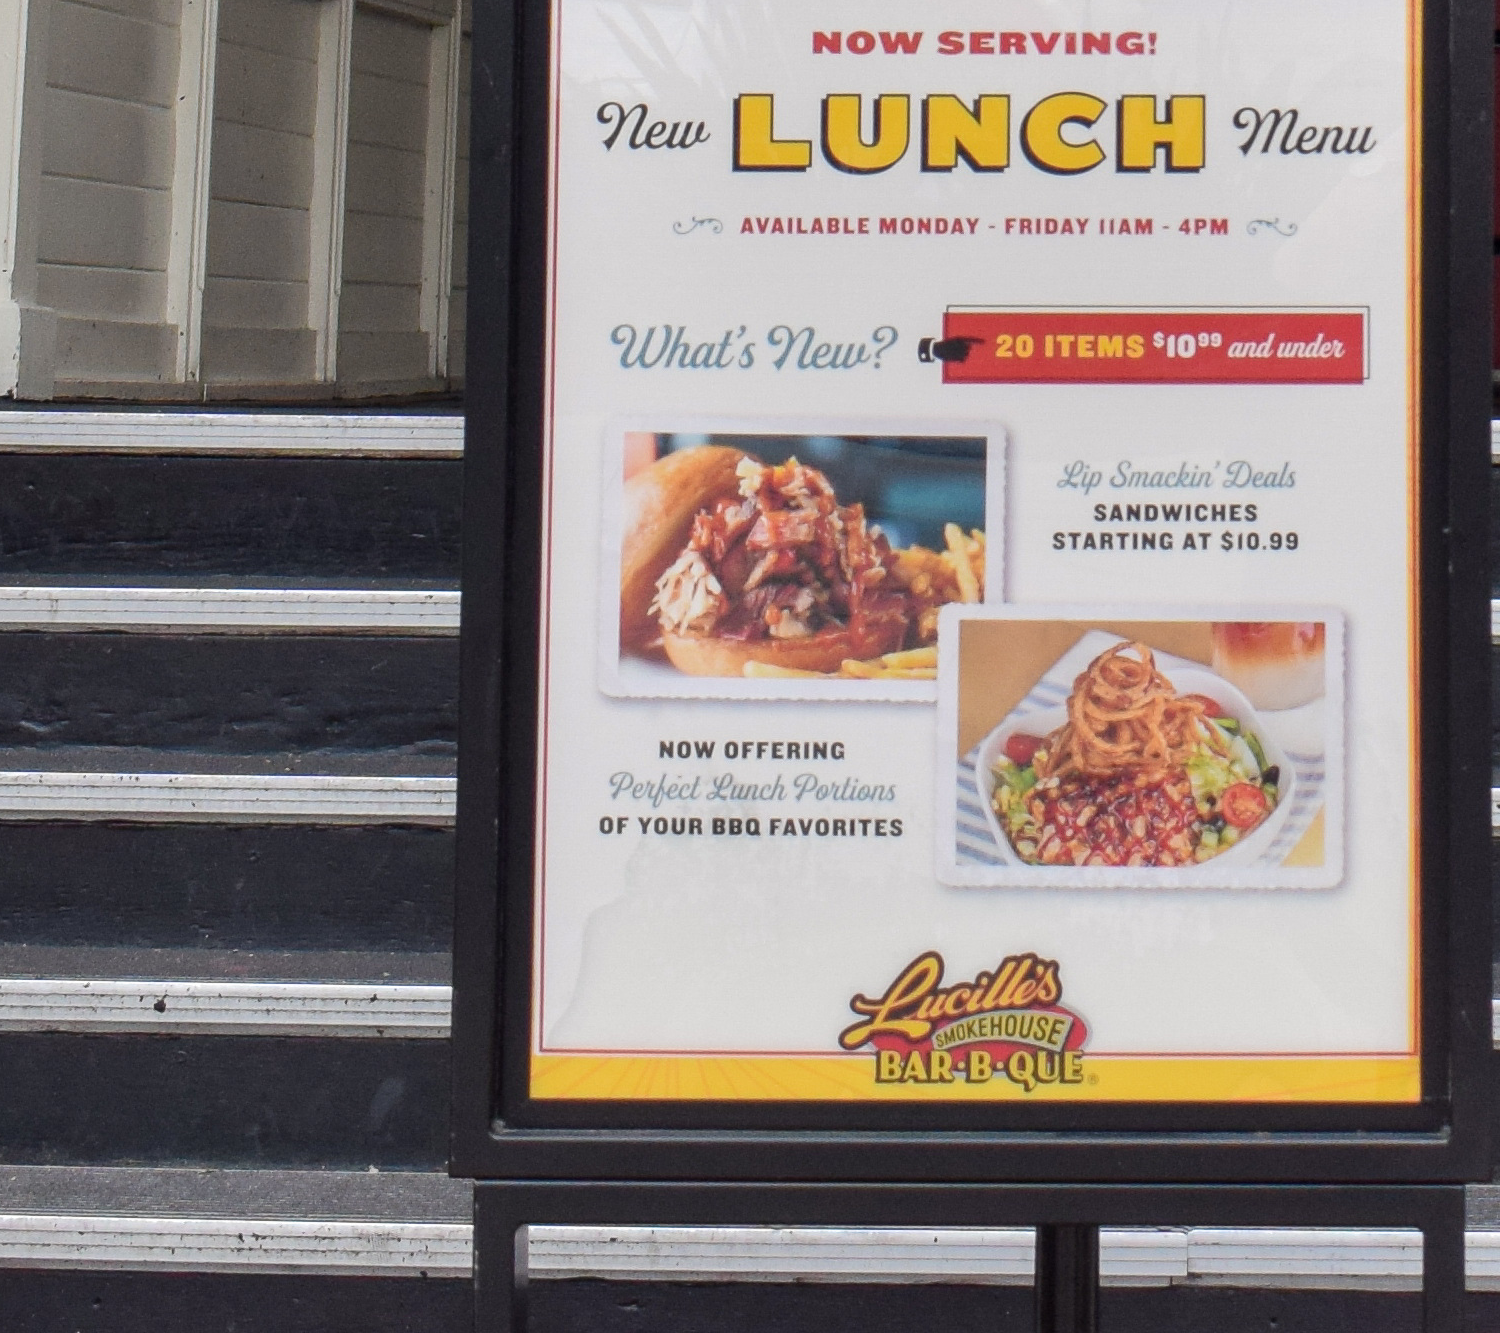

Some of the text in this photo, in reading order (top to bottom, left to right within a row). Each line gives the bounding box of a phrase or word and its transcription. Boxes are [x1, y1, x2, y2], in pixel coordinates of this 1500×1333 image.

[812, 31, 1159, 58] NOW SERVING!
[597, 90, 1378, 175] New LUNCH Menu
[741, 217, 871, 236] AVAILABLE
[879, 217, 981, 236] MONDAY
[1005, 218, 1090, 236] FRIDAY
[1100, 218, 1155, 237] 11AM
[1179, 218, 1230, 237] 4PM
[610, 323, 899, 372] What's New?
[995, 334, 1034, 358] 20
[1044, 334, 1145, 359] ITEMS
[1227, 333, 1273, 359] and
[1276, 332, 1346, 359] under
[1056, 461, 1297, 494] Lip Smackin' Deals
[1094, 504, 1259, 524] SANDWICHES
[1053, 531, 1300, 554] STARTING AT $10.99
[659, 741, 846, 762] NOW OFFERING
[608, 773, 897, 806] Perfect Lunch Portions
[600, 816, 904, 839] OF YOUR BBQ FAVORITES
[839, 951, 1062, 1049] Lucille's
[934, 1010, 1066, 1049] SMOKEHOUSE
